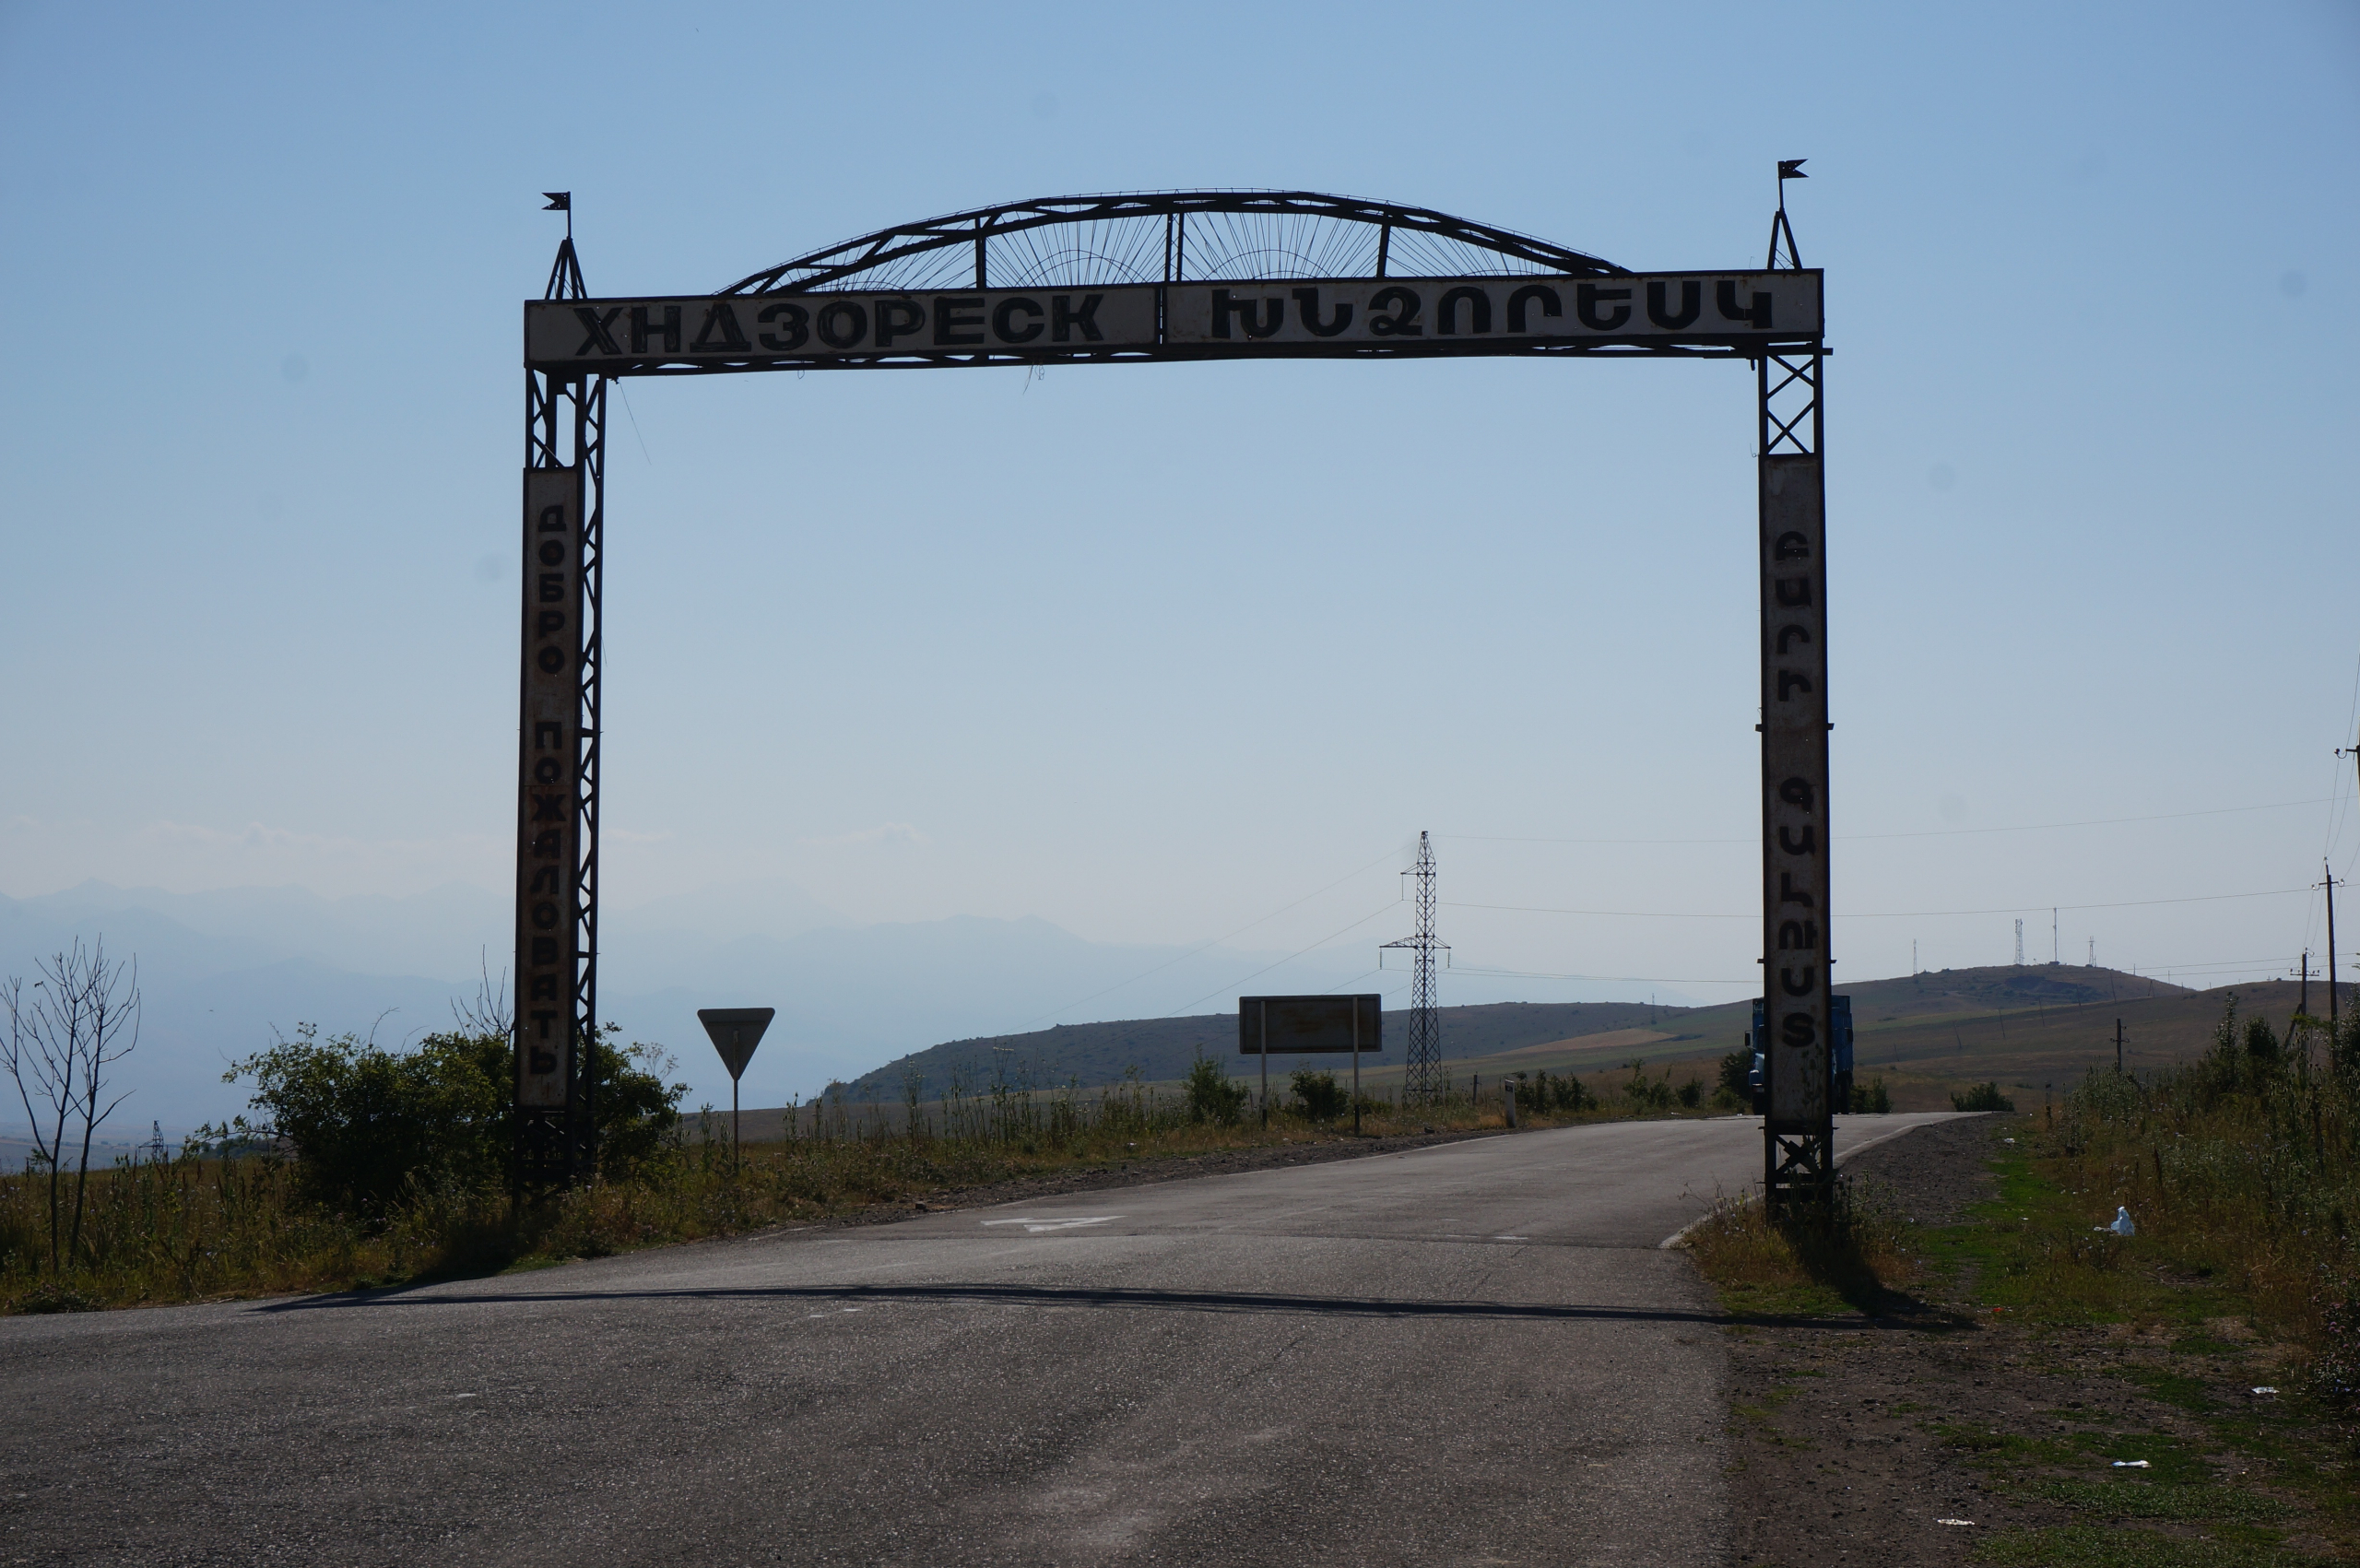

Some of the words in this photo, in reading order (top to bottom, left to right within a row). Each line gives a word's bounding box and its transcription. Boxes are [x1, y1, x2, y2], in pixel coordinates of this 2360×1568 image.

[575, 294, 1104, 356] ХНДЗОРЕСК
[1210, 279, 1773, 339] ԽՆՁՈՐԵՍԿ
[537, 505, 567, 674] ДОБРО
[1776, 531, 1812, 701] ԲԱՐԻ
[530, 722, 567, 1075] ПОЖАЛОВАТЬ
